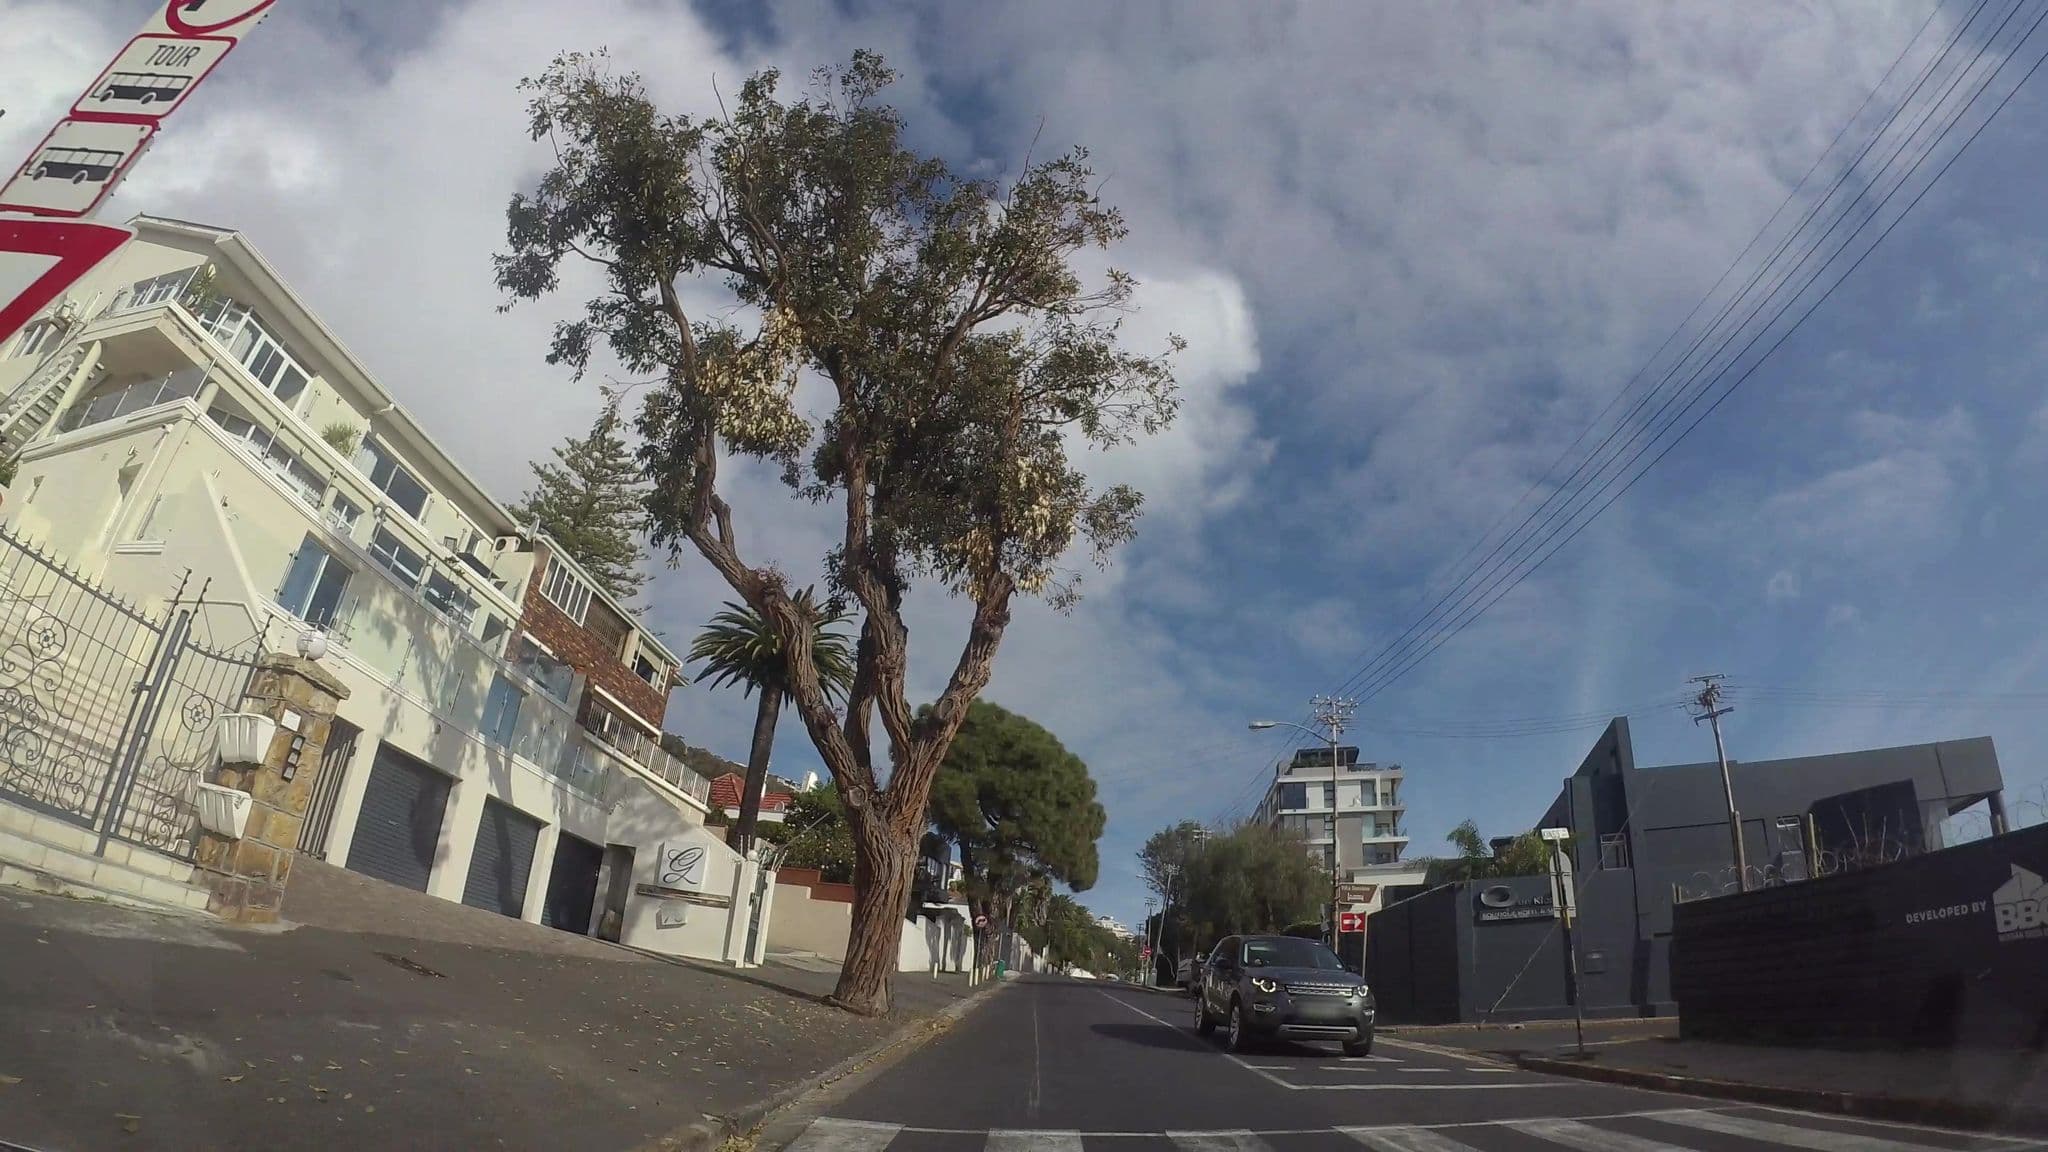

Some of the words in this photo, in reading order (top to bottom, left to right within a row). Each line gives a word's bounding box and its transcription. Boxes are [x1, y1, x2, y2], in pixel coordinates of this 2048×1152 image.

[145, 44, 201, 67] TOUR
[1905, 904, 1969, 924] DEVELOPED
[1972, 900, 1987, 913] BY
